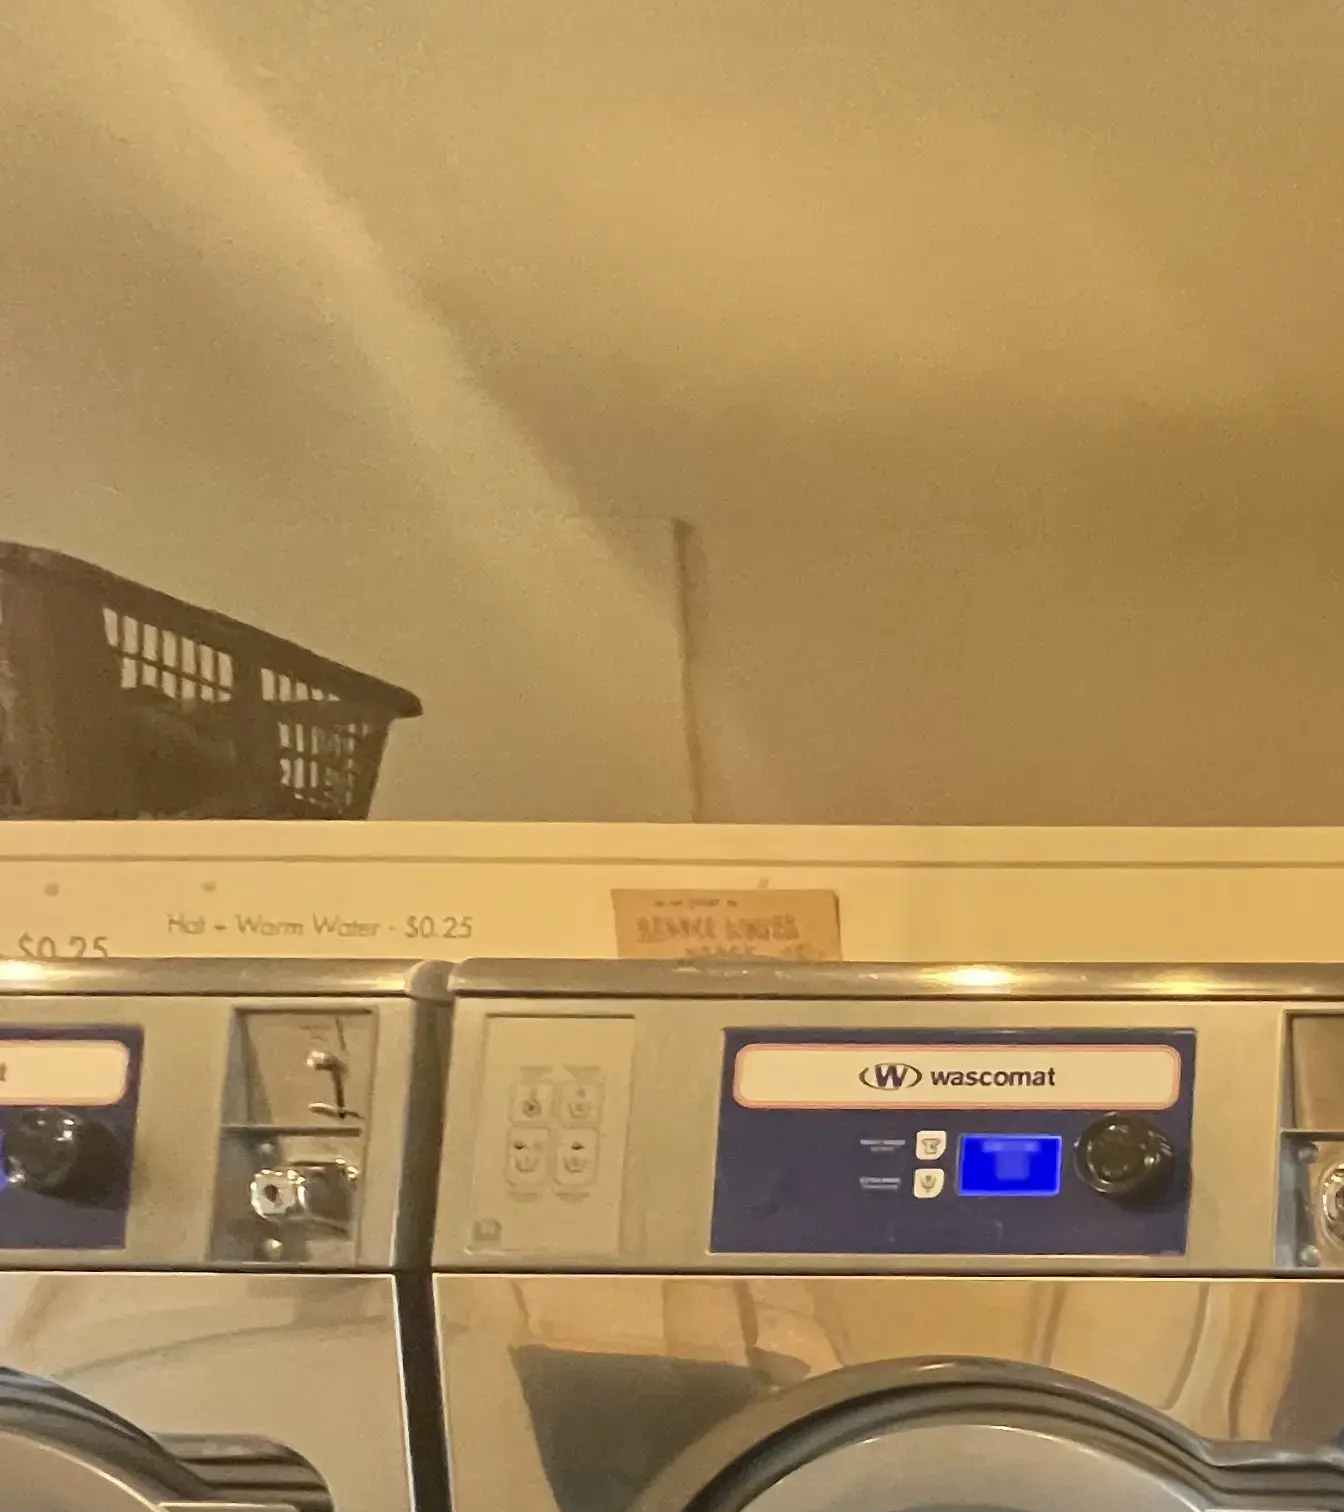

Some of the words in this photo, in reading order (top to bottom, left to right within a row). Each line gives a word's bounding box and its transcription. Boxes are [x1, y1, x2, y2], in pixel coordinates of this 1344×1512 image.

[312, 914, 380, 938] Water
[18, 932, 109, 958] $025
[930, 1067, 1056, 1087] wascomat
